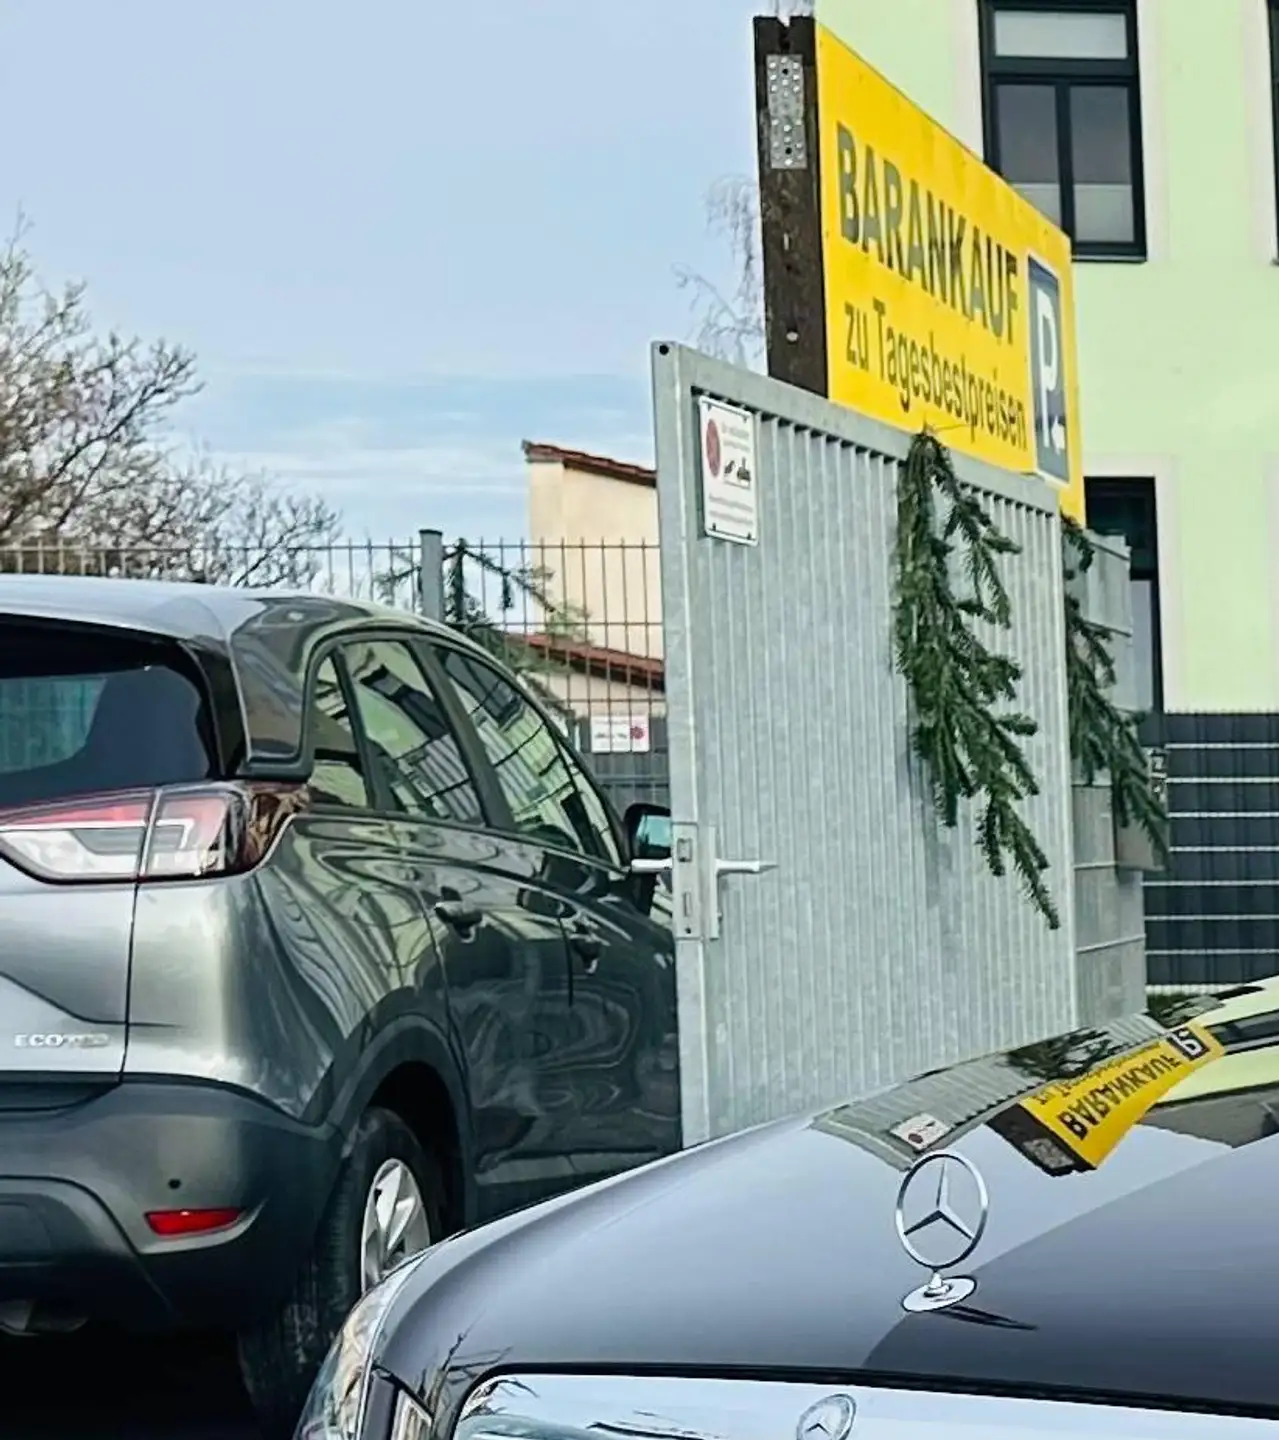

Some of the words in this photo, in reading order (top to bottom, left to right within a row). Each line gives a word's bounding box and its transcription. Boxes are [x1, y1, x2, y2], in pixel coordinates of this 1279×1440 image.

[837, 120, 1018, 344] BARANKAUF
[845, 301, 870, 372] zu
[873, 297, 1028, 452] Tagesbestpreisen
[1036, 288, 1058, 448] P
